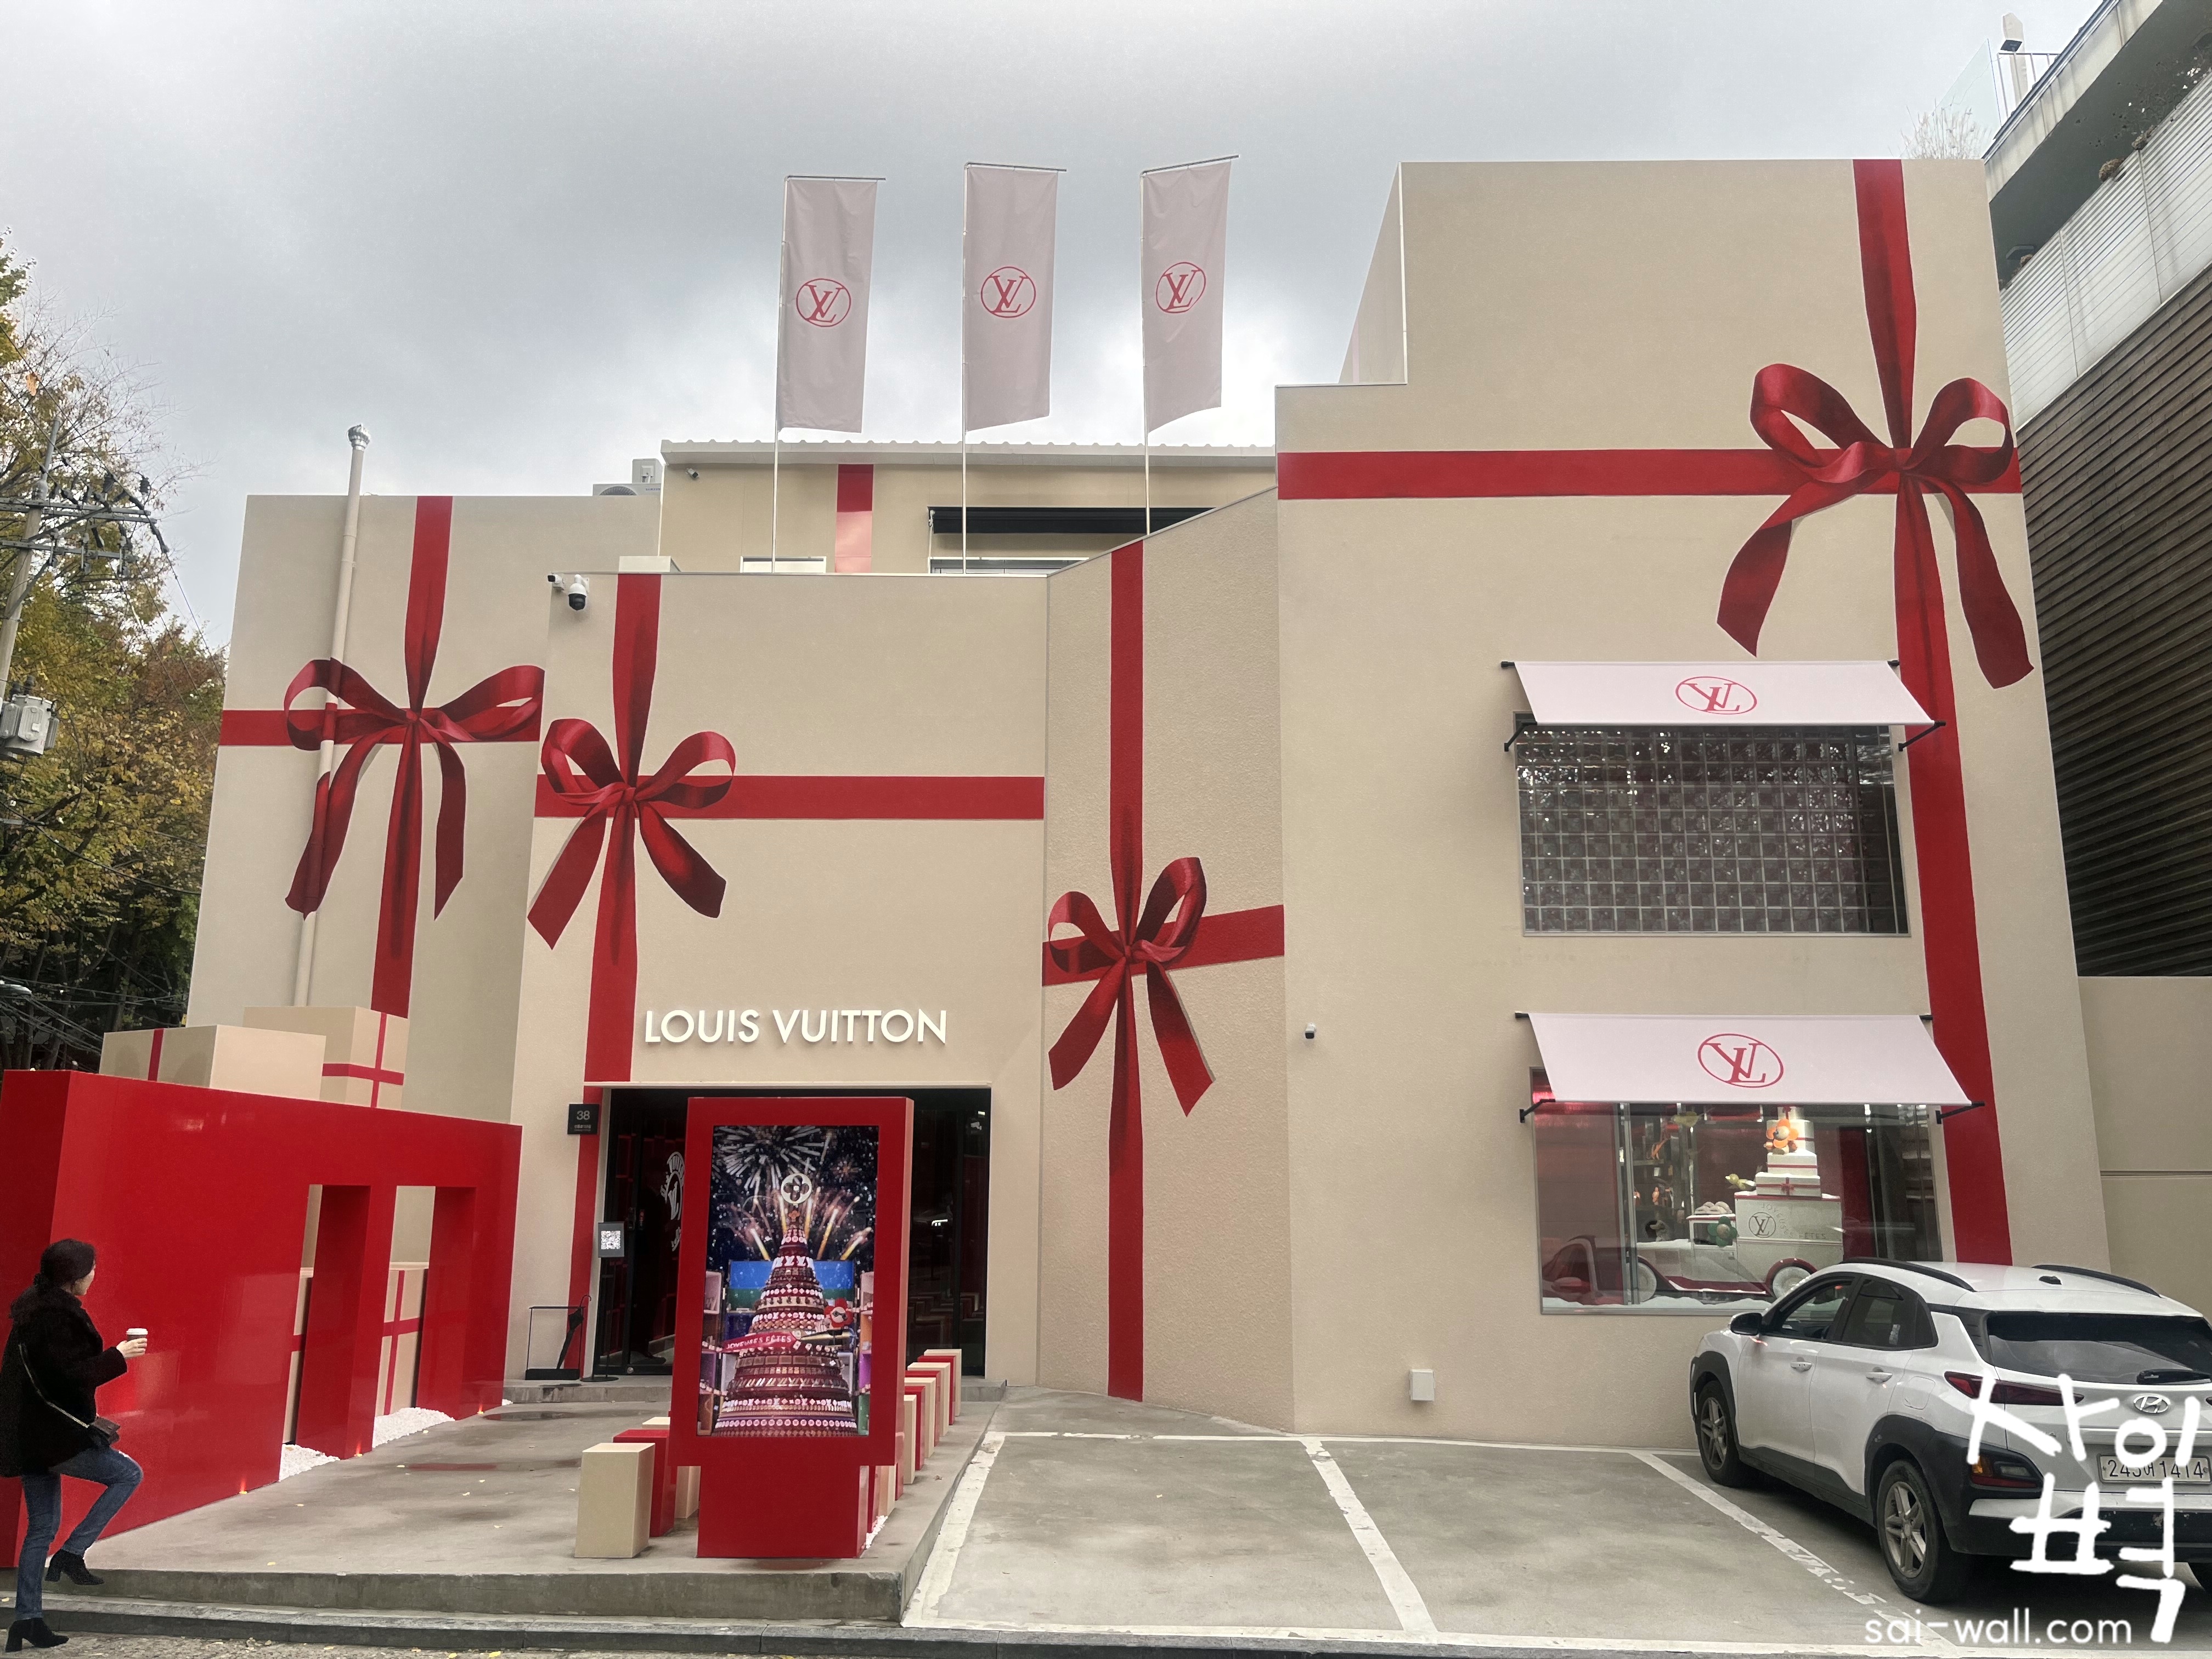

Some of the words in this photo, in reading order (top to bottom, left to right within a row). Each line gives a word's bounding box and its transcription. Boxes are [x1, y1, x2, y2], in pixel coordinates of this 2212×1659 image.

[645, 1009, 760, 1043] LOUIS
[772, 1008, 947, 1044] VUITTON
[577, 1110, 590, 1120] 38
[2159, 1461, 2204, 1478] 1414
